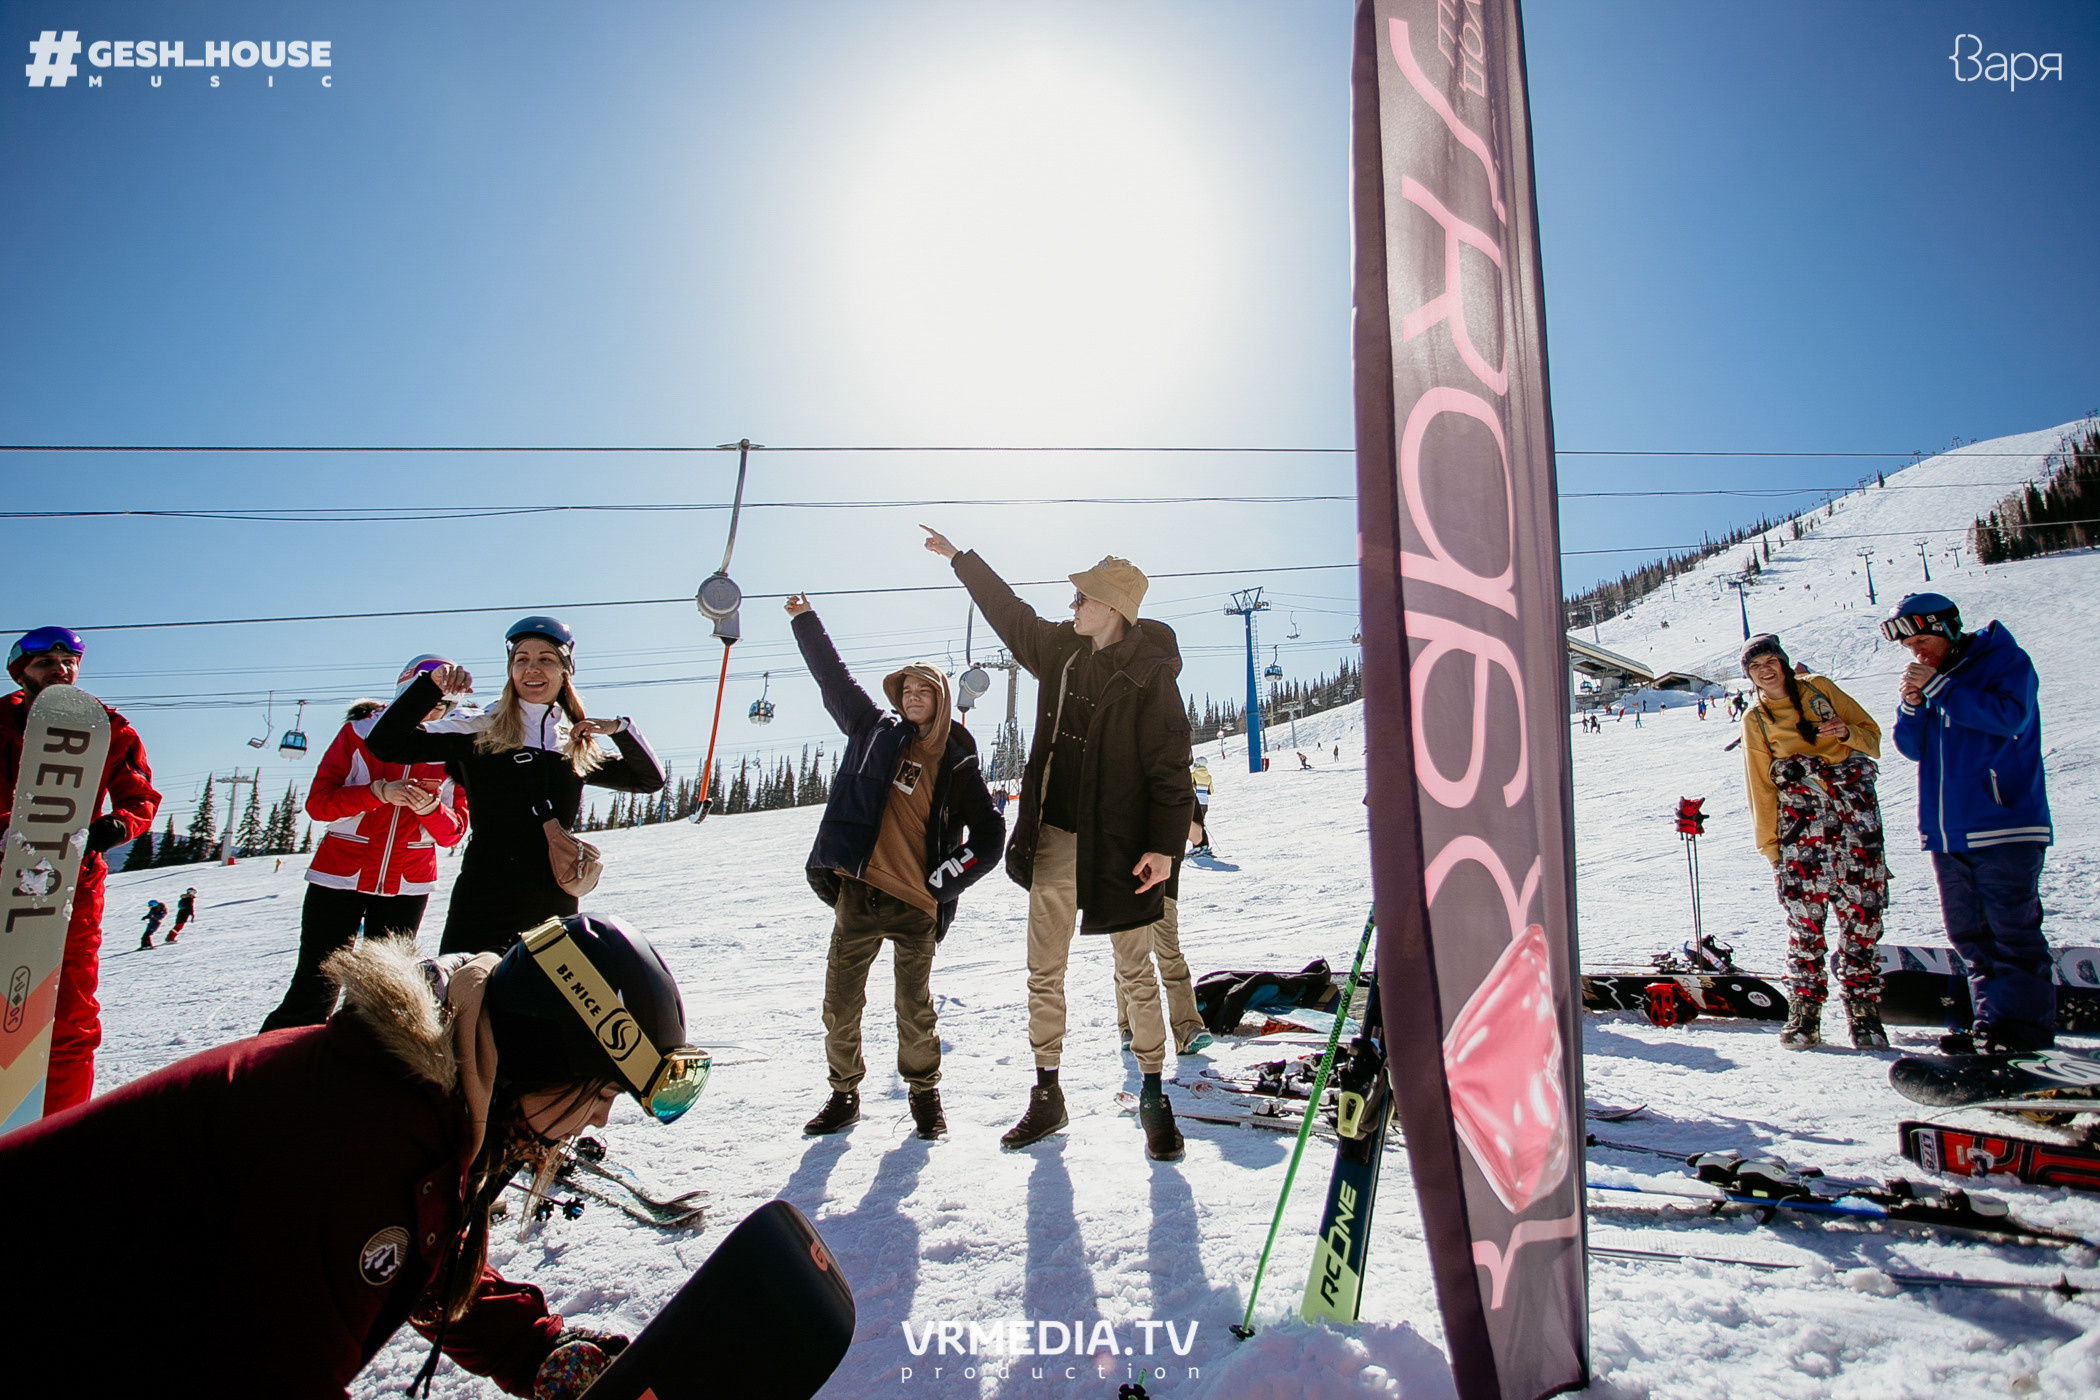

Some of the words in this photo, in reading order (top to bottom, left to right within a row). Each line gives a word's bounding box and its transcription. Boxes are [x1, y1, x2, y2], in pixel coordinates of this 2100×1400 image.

[928, 847, 977, 889] FILA
[556, 963, 574, 983] BE
[571, 982, 602, 1017] NICE
